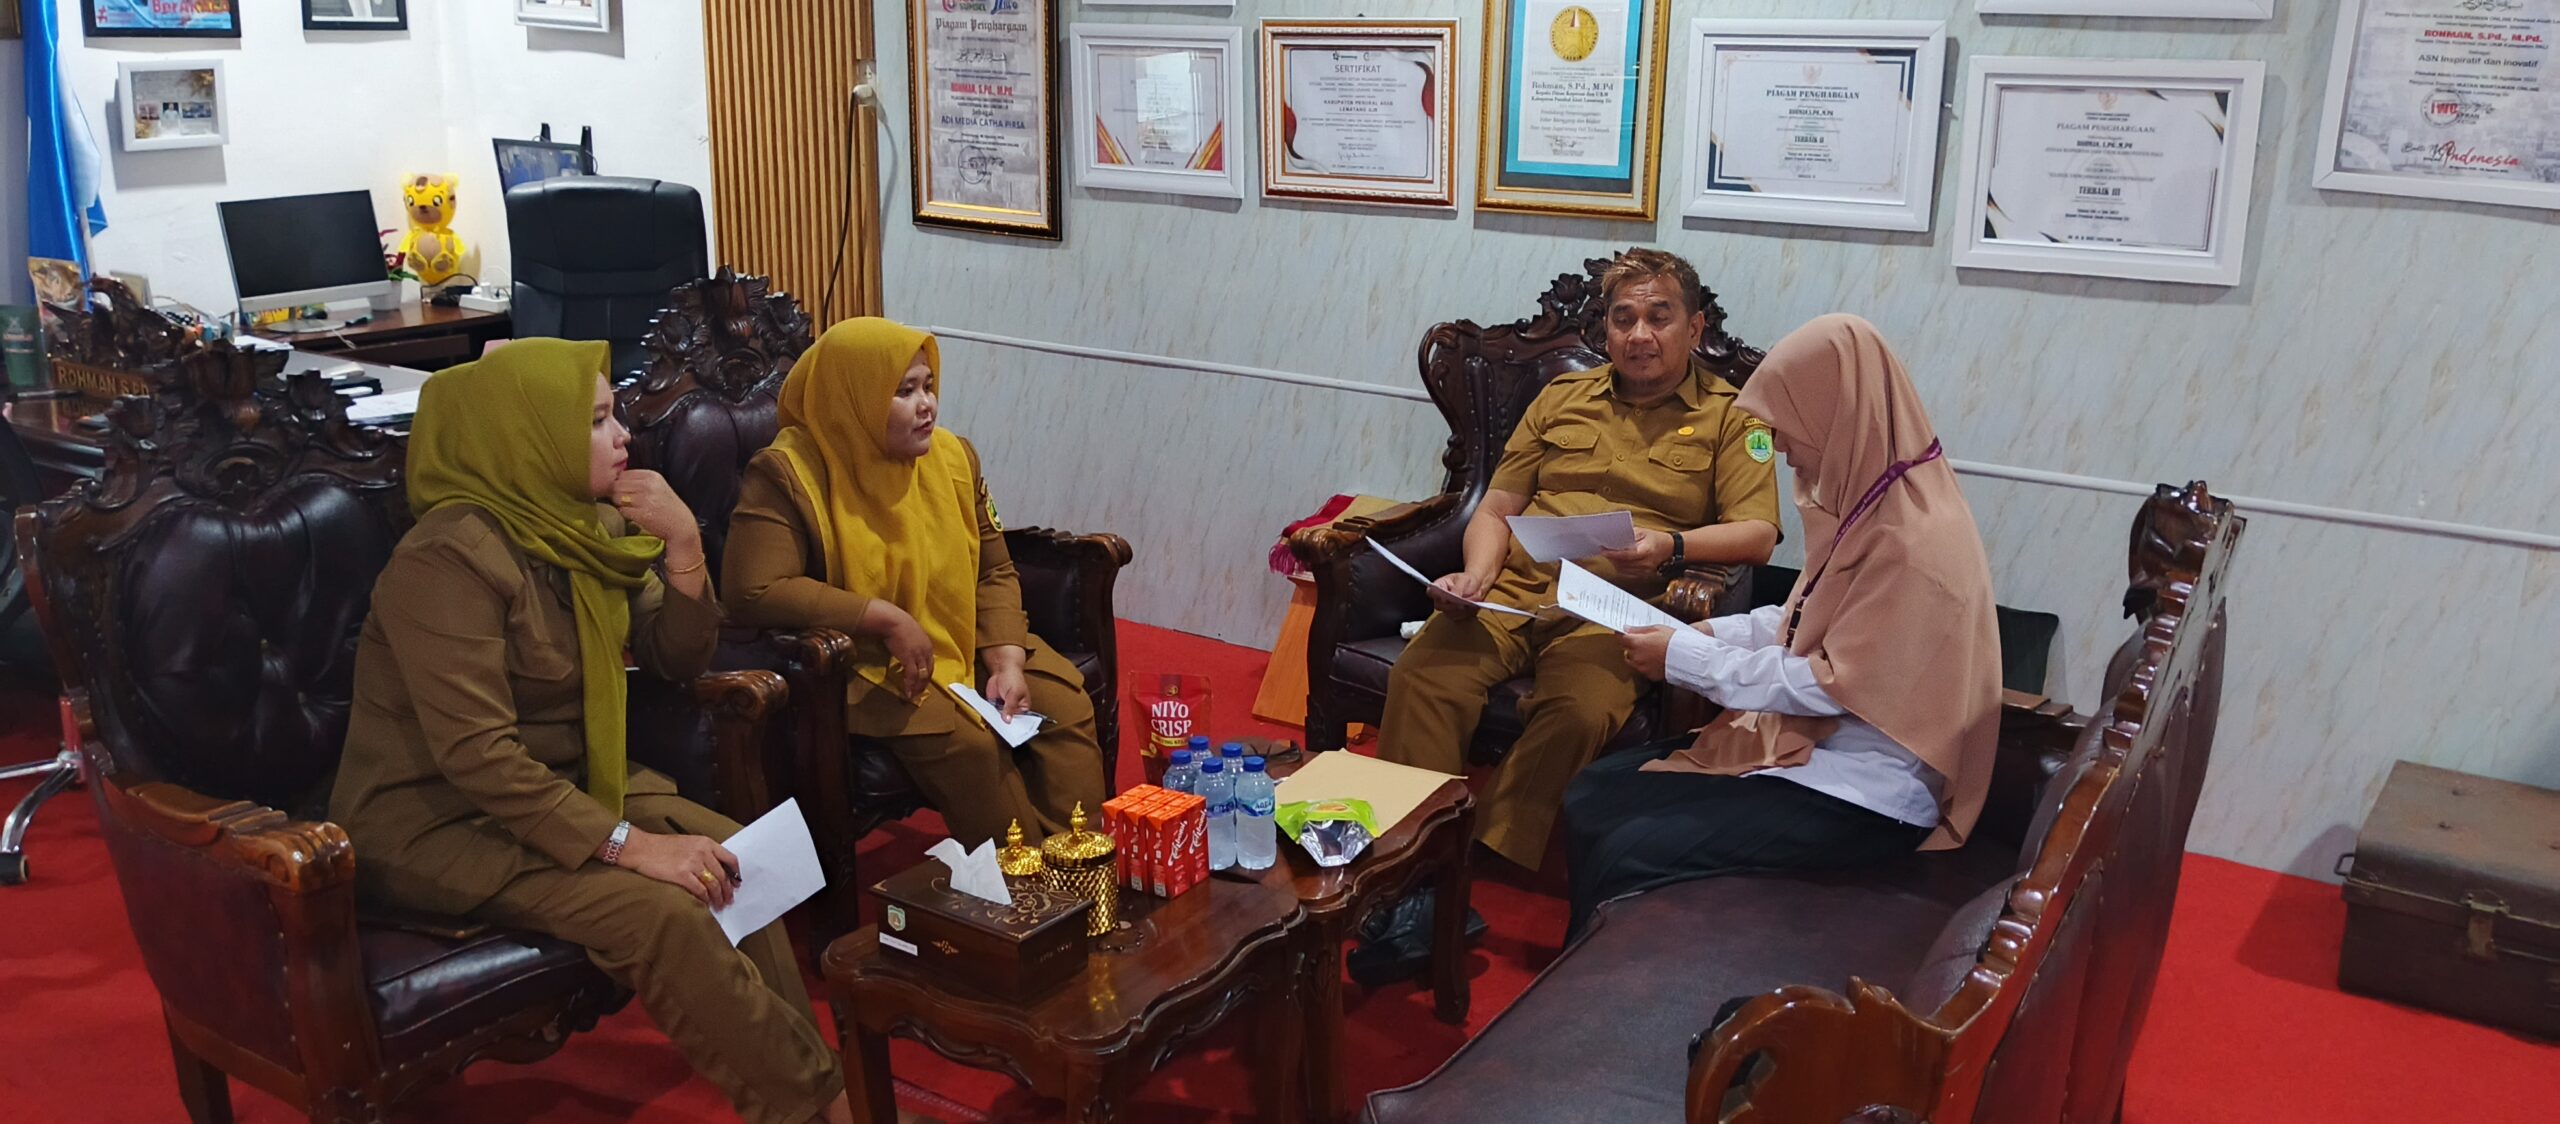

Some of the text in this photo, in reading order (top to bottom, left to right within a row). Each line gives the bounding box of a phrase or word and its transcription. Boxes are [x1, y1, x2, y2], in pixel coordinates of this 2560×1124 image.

[935, 18, 1028, 33] Piagam Penghargaan
[2424, 29, 2474, 40] ROHMAN,
[2511, 33, 2543, 43] M.Pd.
[2418, 54, 2439, 62] ASN
[2441, 55, 2481, 66] Inspiratif
[2483, 57, 2501, 66] dan
[1334, 64, 1382, 73] SERTIFIKAT
[1766, 89, 1860, 99] PIAGAM PENGHARGAAN
[941, 115, 954, 125] ADI
[955, 116, 978, 126] MEDIA
[2057, 123, 2155, 133] PIAGAM PENGHARGAAN
[2079, 186, 2109, 196] TERBAIK
[58, 367, 116, 394] ROHMAN
[1152, 700, 1189, 718] NIYO
[1151, 719, 1192, 737] CRISP
